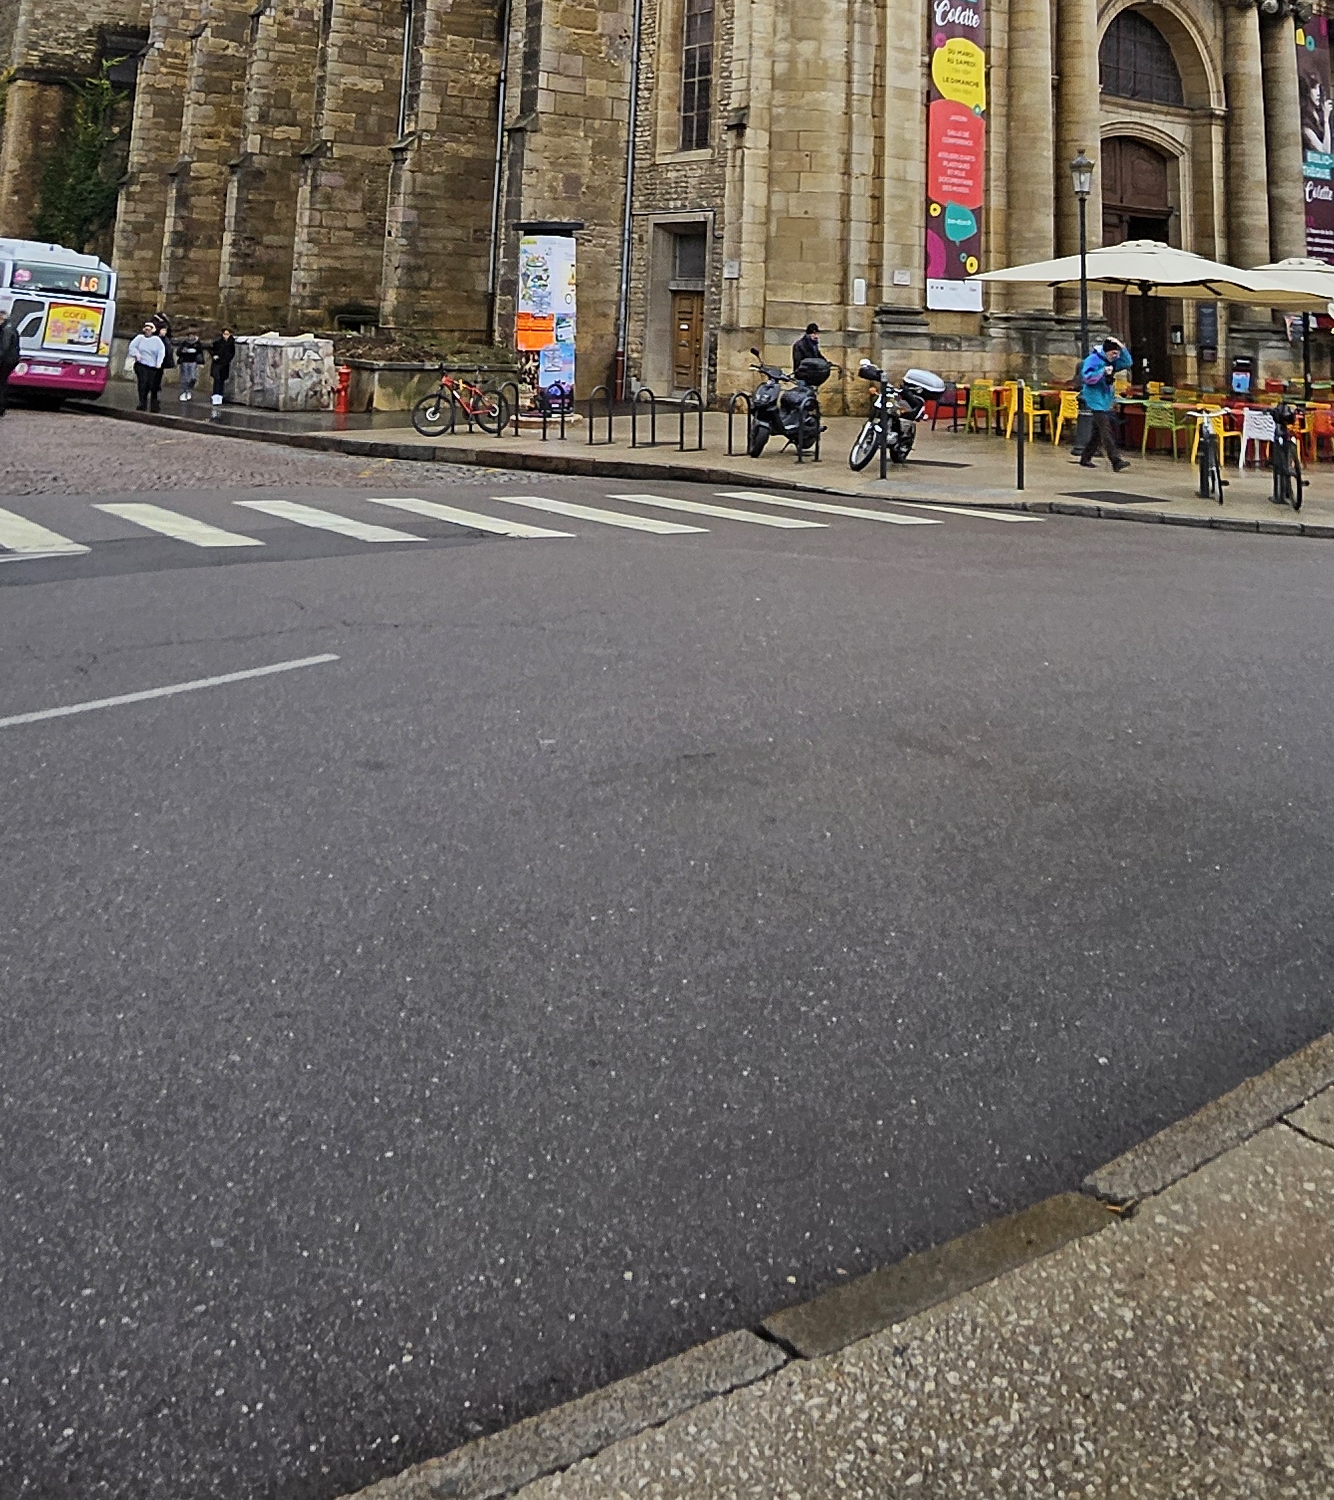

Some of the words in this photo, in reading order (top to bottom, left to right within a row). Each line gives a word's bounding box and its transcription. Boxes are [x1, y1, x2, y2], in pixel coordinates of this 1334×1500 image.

[934, 0, 980, 28] Colette
[80, 275, 99, 292] L6
[62, 310, 87, 320] cora
